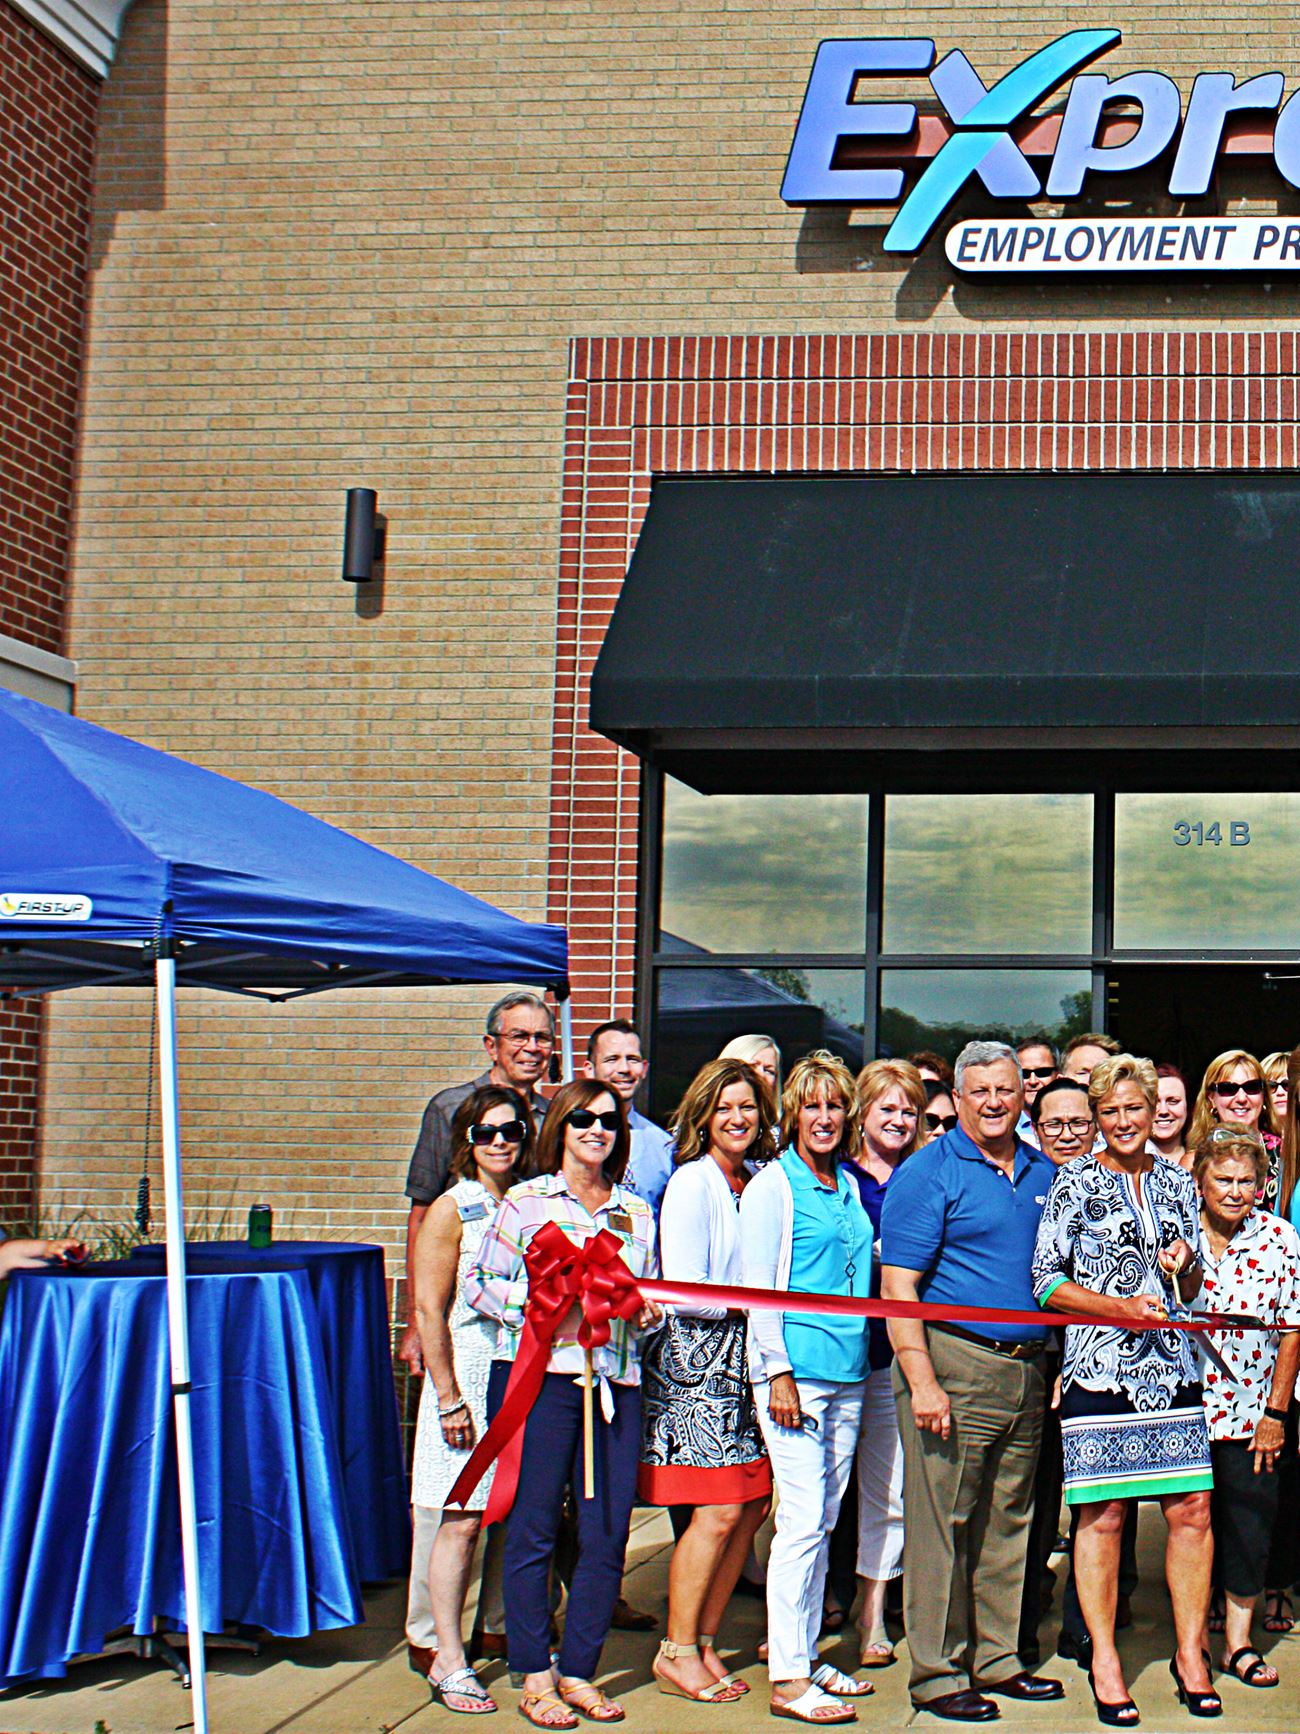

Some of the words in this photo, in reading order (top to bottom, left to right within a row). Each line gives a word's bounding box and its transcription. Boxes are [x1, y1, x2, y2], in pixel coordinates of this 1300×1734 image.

[957, 226, 1236, 263] EMPLOYMENT
[1173, 821, 1222, 846] 314
[1231, 821, 1250, 846] B
